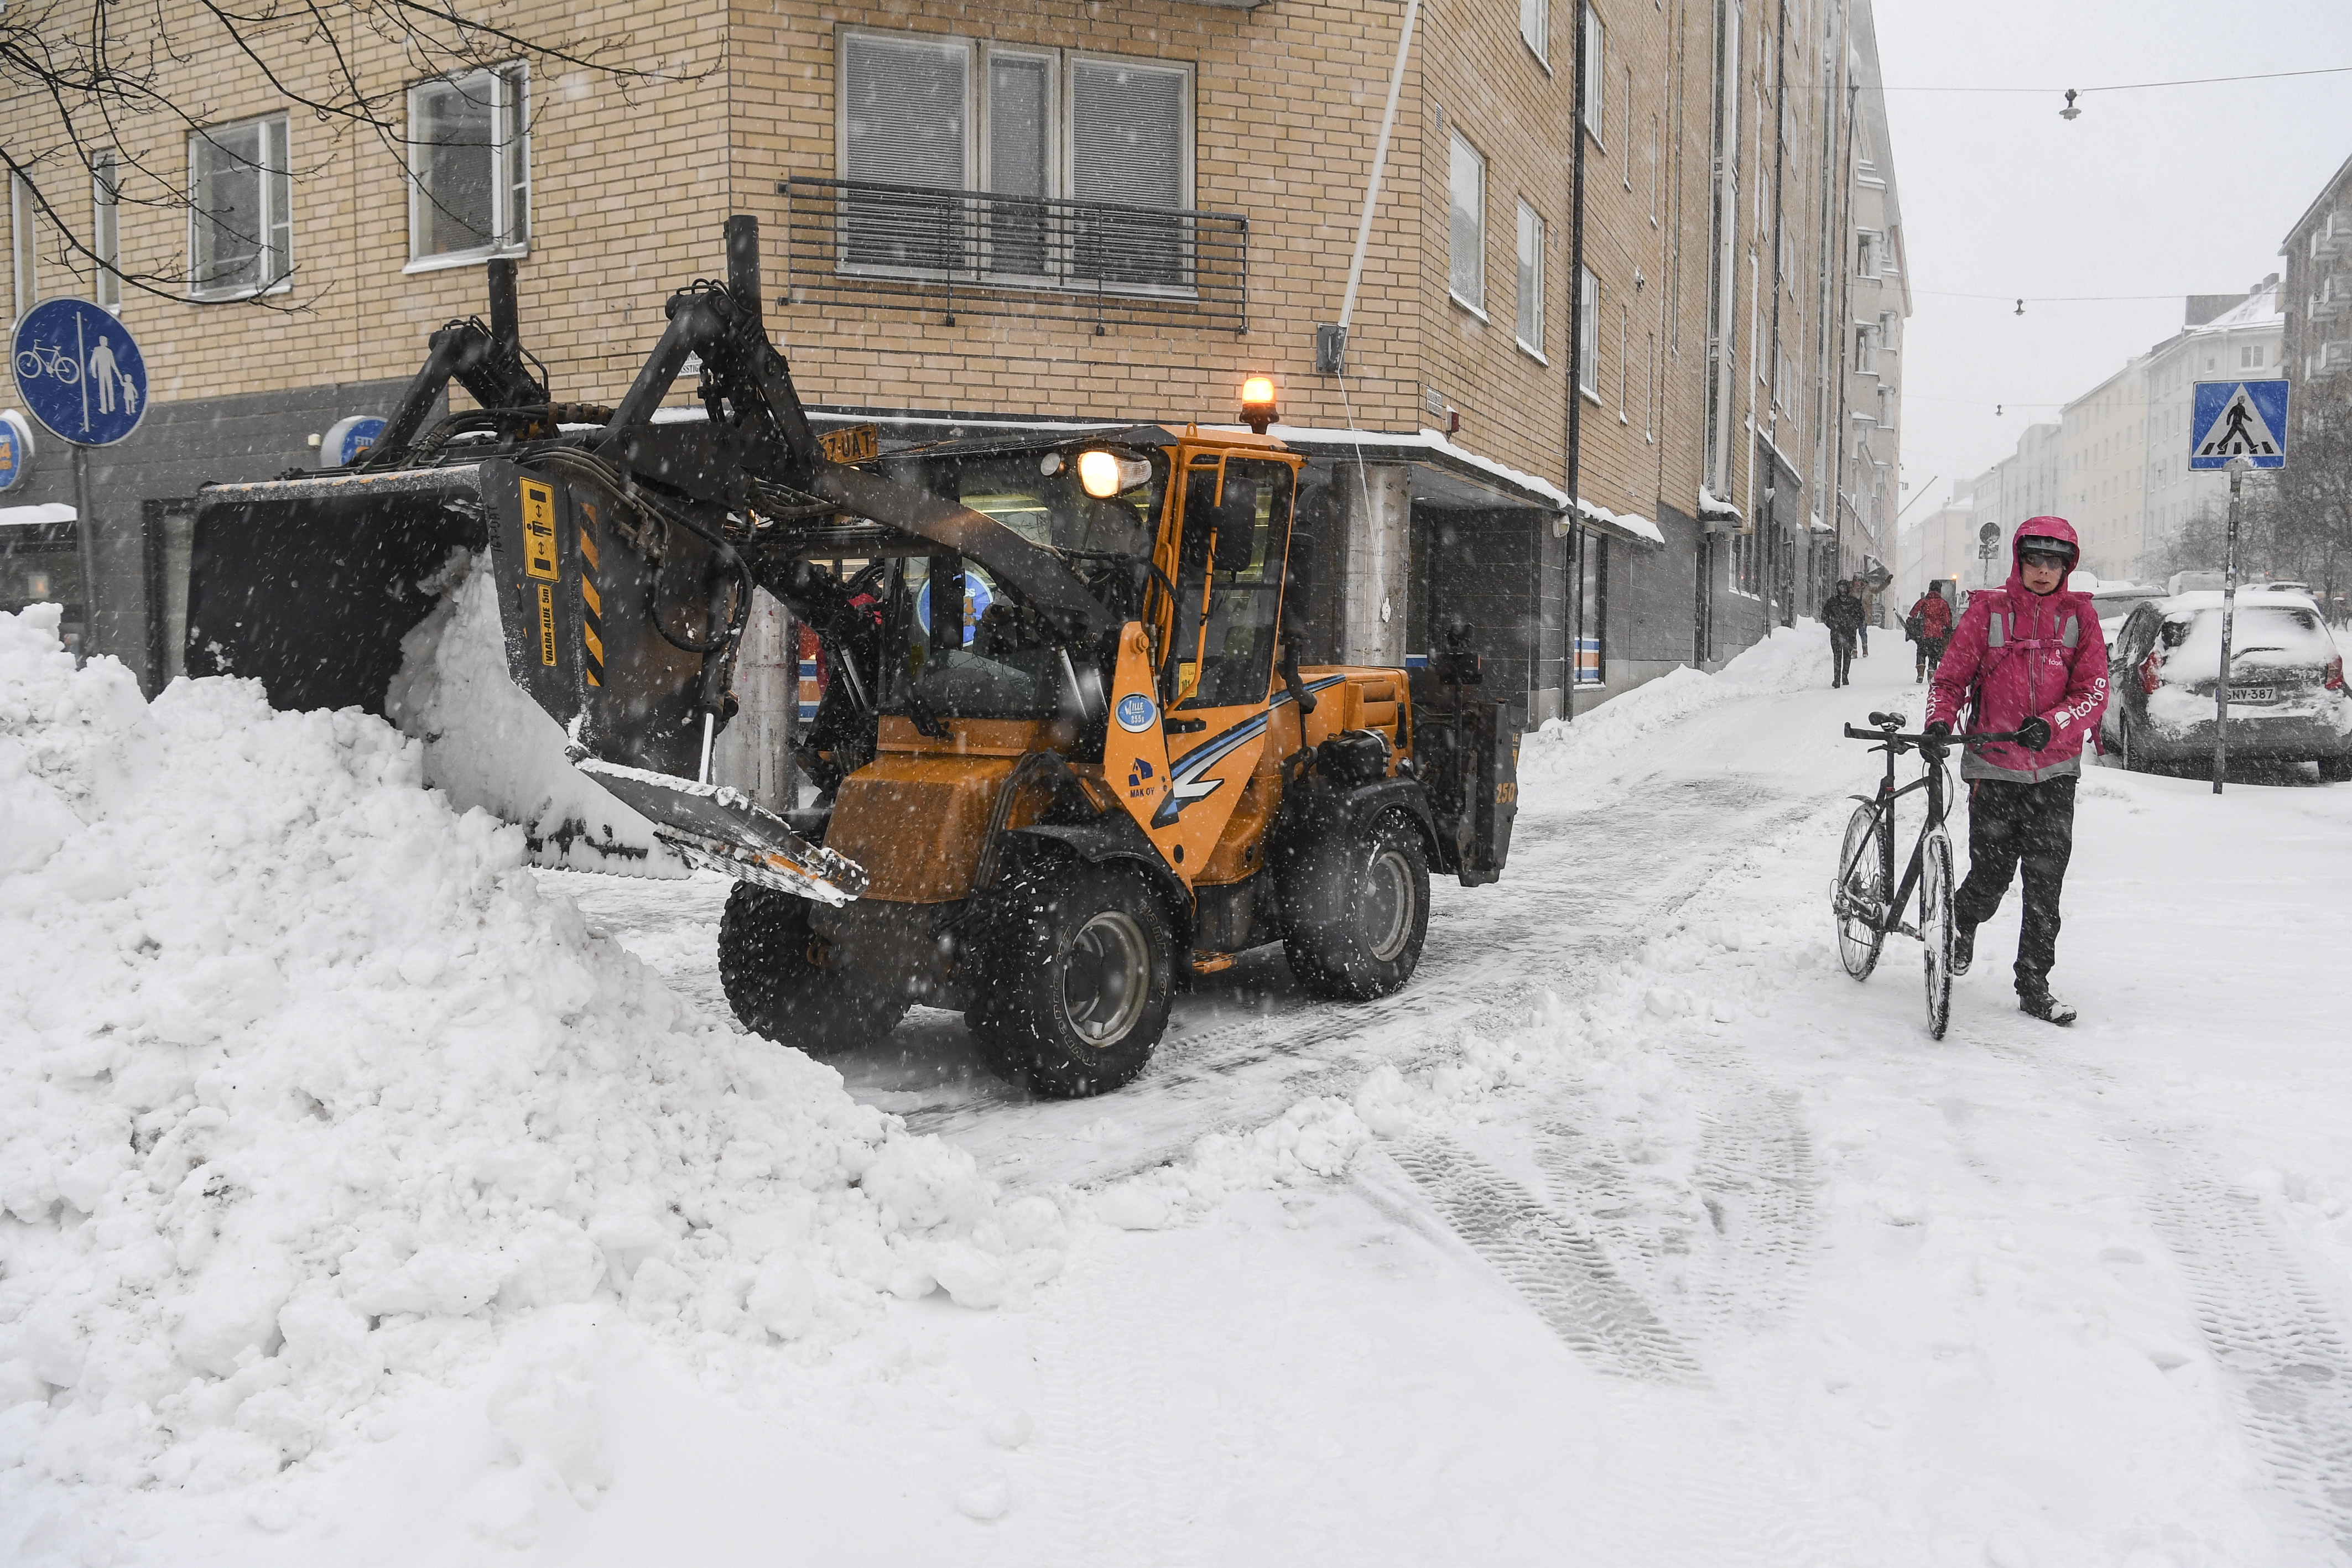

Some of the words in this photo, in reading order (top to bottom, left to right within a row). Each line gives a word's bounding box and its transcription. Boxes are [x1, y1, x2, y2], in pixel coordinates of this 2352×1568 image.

[542, 588, 549, 603] 5m
[543, 607, 553, 661] VAARA-ALUE
[1124, 700, 1144, 716] WILLE
[2068, 678, 2106, 721] foodora
[1130, 788, 1144, 798] MAK
[1146, 786, 1155, 796] OY
[1496, 782, 1515, 804] 250
